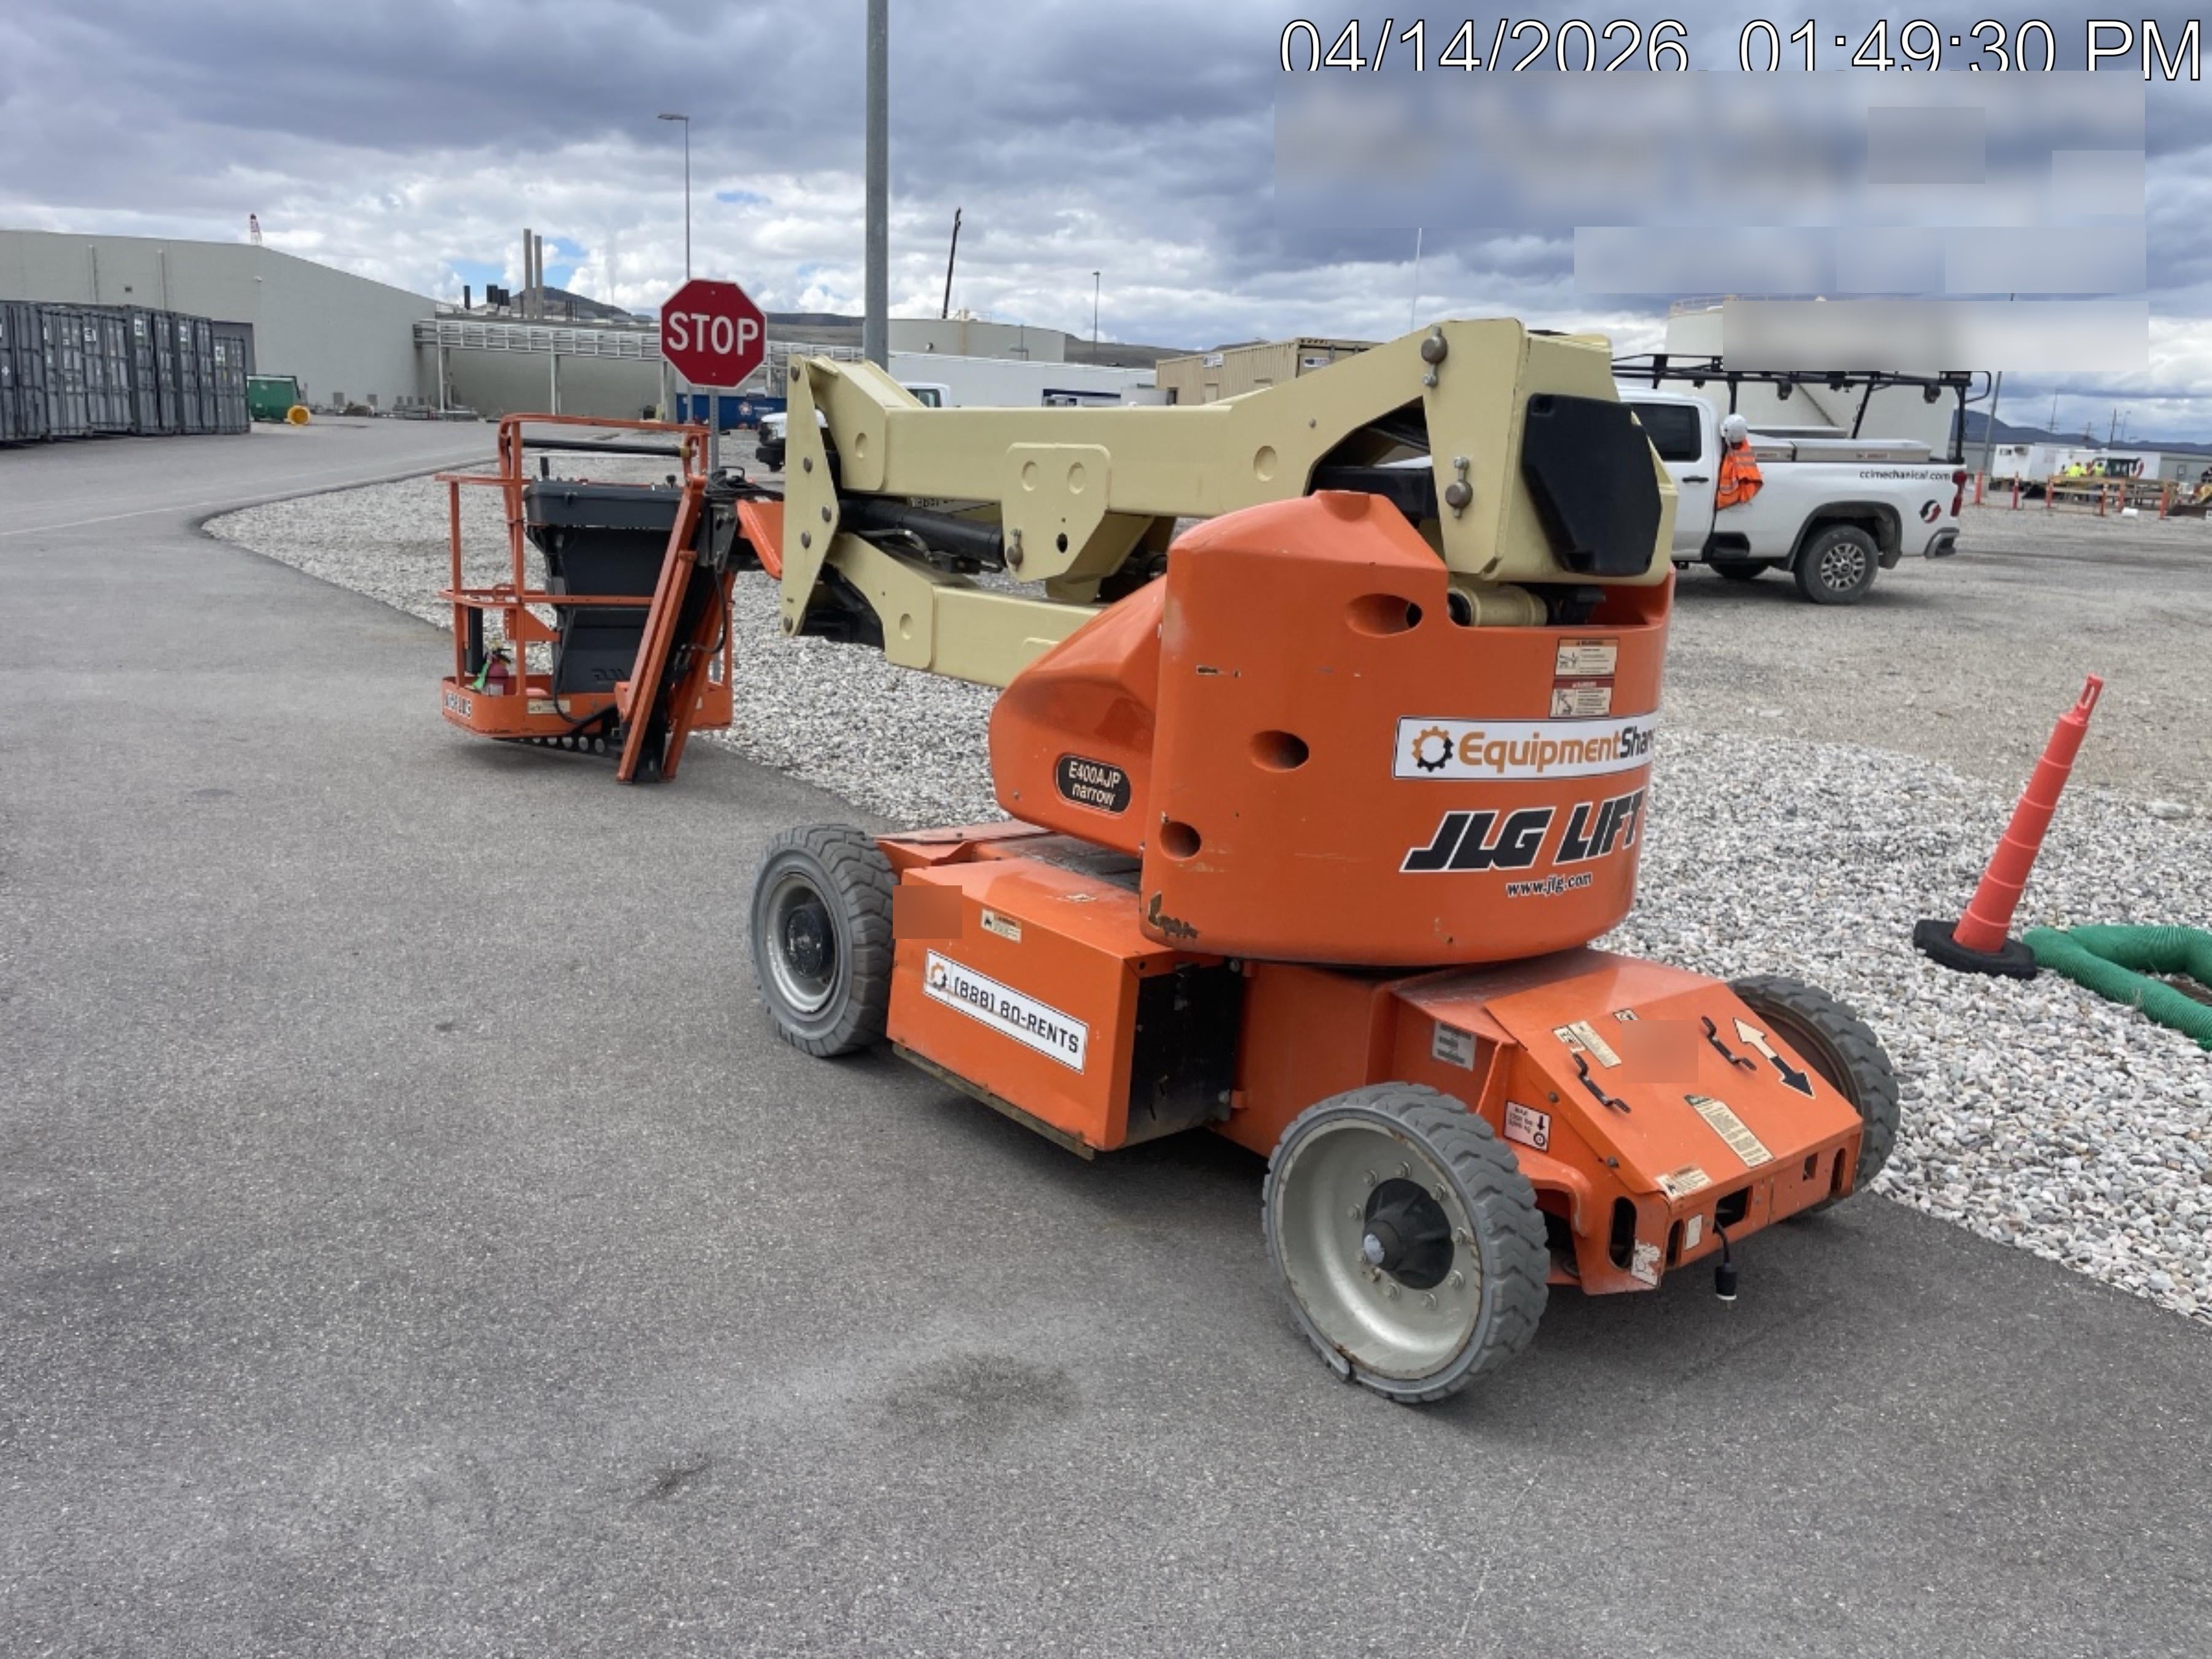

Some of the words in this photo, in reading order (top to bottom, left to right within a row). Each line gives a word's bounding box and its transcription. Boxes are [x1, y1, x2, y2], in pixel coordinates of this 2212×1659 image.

[667, 311, 759, 356] STOP
[1859, 469, 1950, 480] ccimechanical.com
[1459, 725, 1656, 773] EquipmentShar
[1069, 761, 1121, 789] E400AJP
[1072, 783, 1116, 806] narrow
[1399, 806, 1556, 873] JLG
[1552, 786, 1646, 866] LIFT
[1507, 873, 1593, 897] www.jlg.com
[954, 976, 995, 1012] (888)
[1000, 1000, 1080, 1054] 80-RENTS
